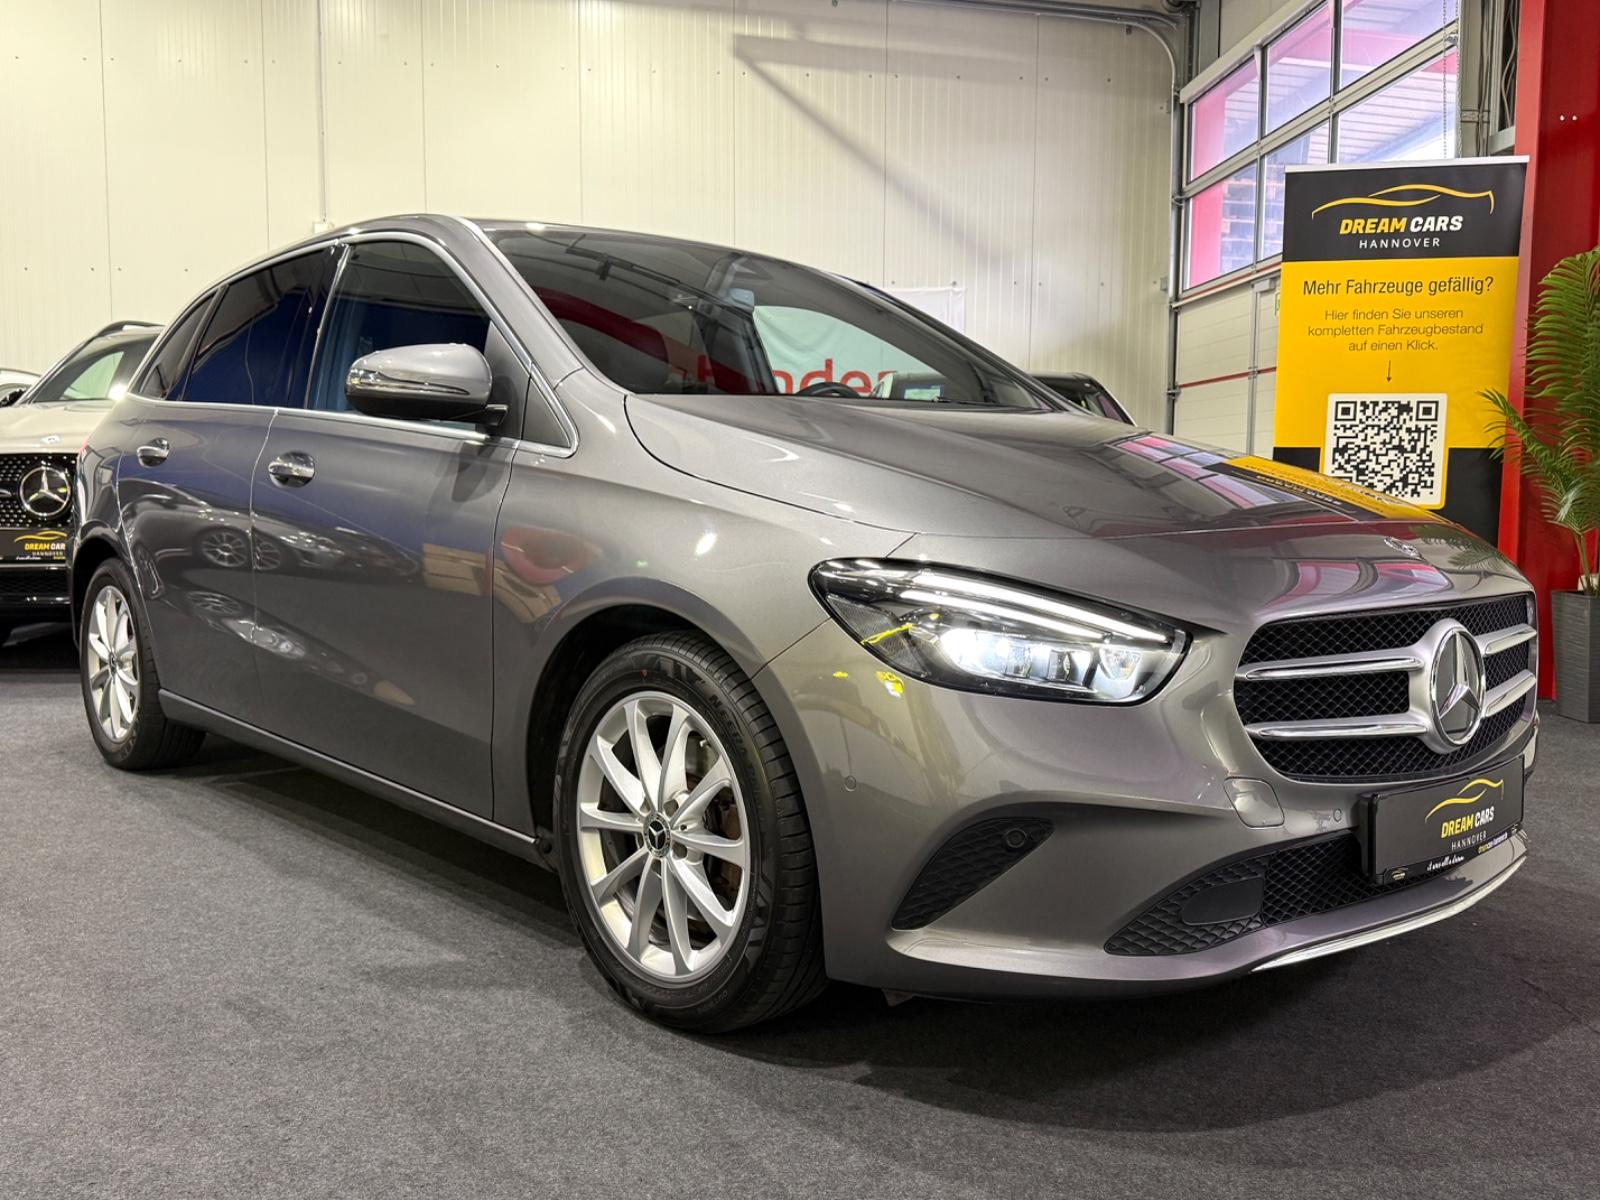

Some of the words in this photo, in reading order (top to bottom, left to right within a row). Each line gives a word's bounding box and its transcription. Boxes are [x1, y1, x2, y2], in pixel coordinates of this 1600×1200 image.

[1339, 217, 1407, 235] DREAM
[1409, 215, 1464, 233] CARS
[1359, 237, 1441, 249] HANNOVER
[1303, 279, 1341, 296] Mehr
[1346, 278, 1423, 296] Fahrzeuge
[1428, 276, 1494, 296] gefällig?
[1325, 309, 1349, 321] Hier
[1352, 309, 1389, 320] finden
[1392, 308, 1412, 319] Sie
[1414, 308, 1464, 319] unseren
[1307, 325, 1375, 337] kompletten
[1377, 323, 1484, 336] Fahrzeugbestand
[1348, 340, 1368, 351] auf
[1370, 340, 1403, 350] einen
[1406, 339, 1439, 350] Klick.
[1440, 815, 1474, 838] DREAM
[1474, 806, 1495, 826] CARS
[1451, 830, 1487, 851] HANNOVER
